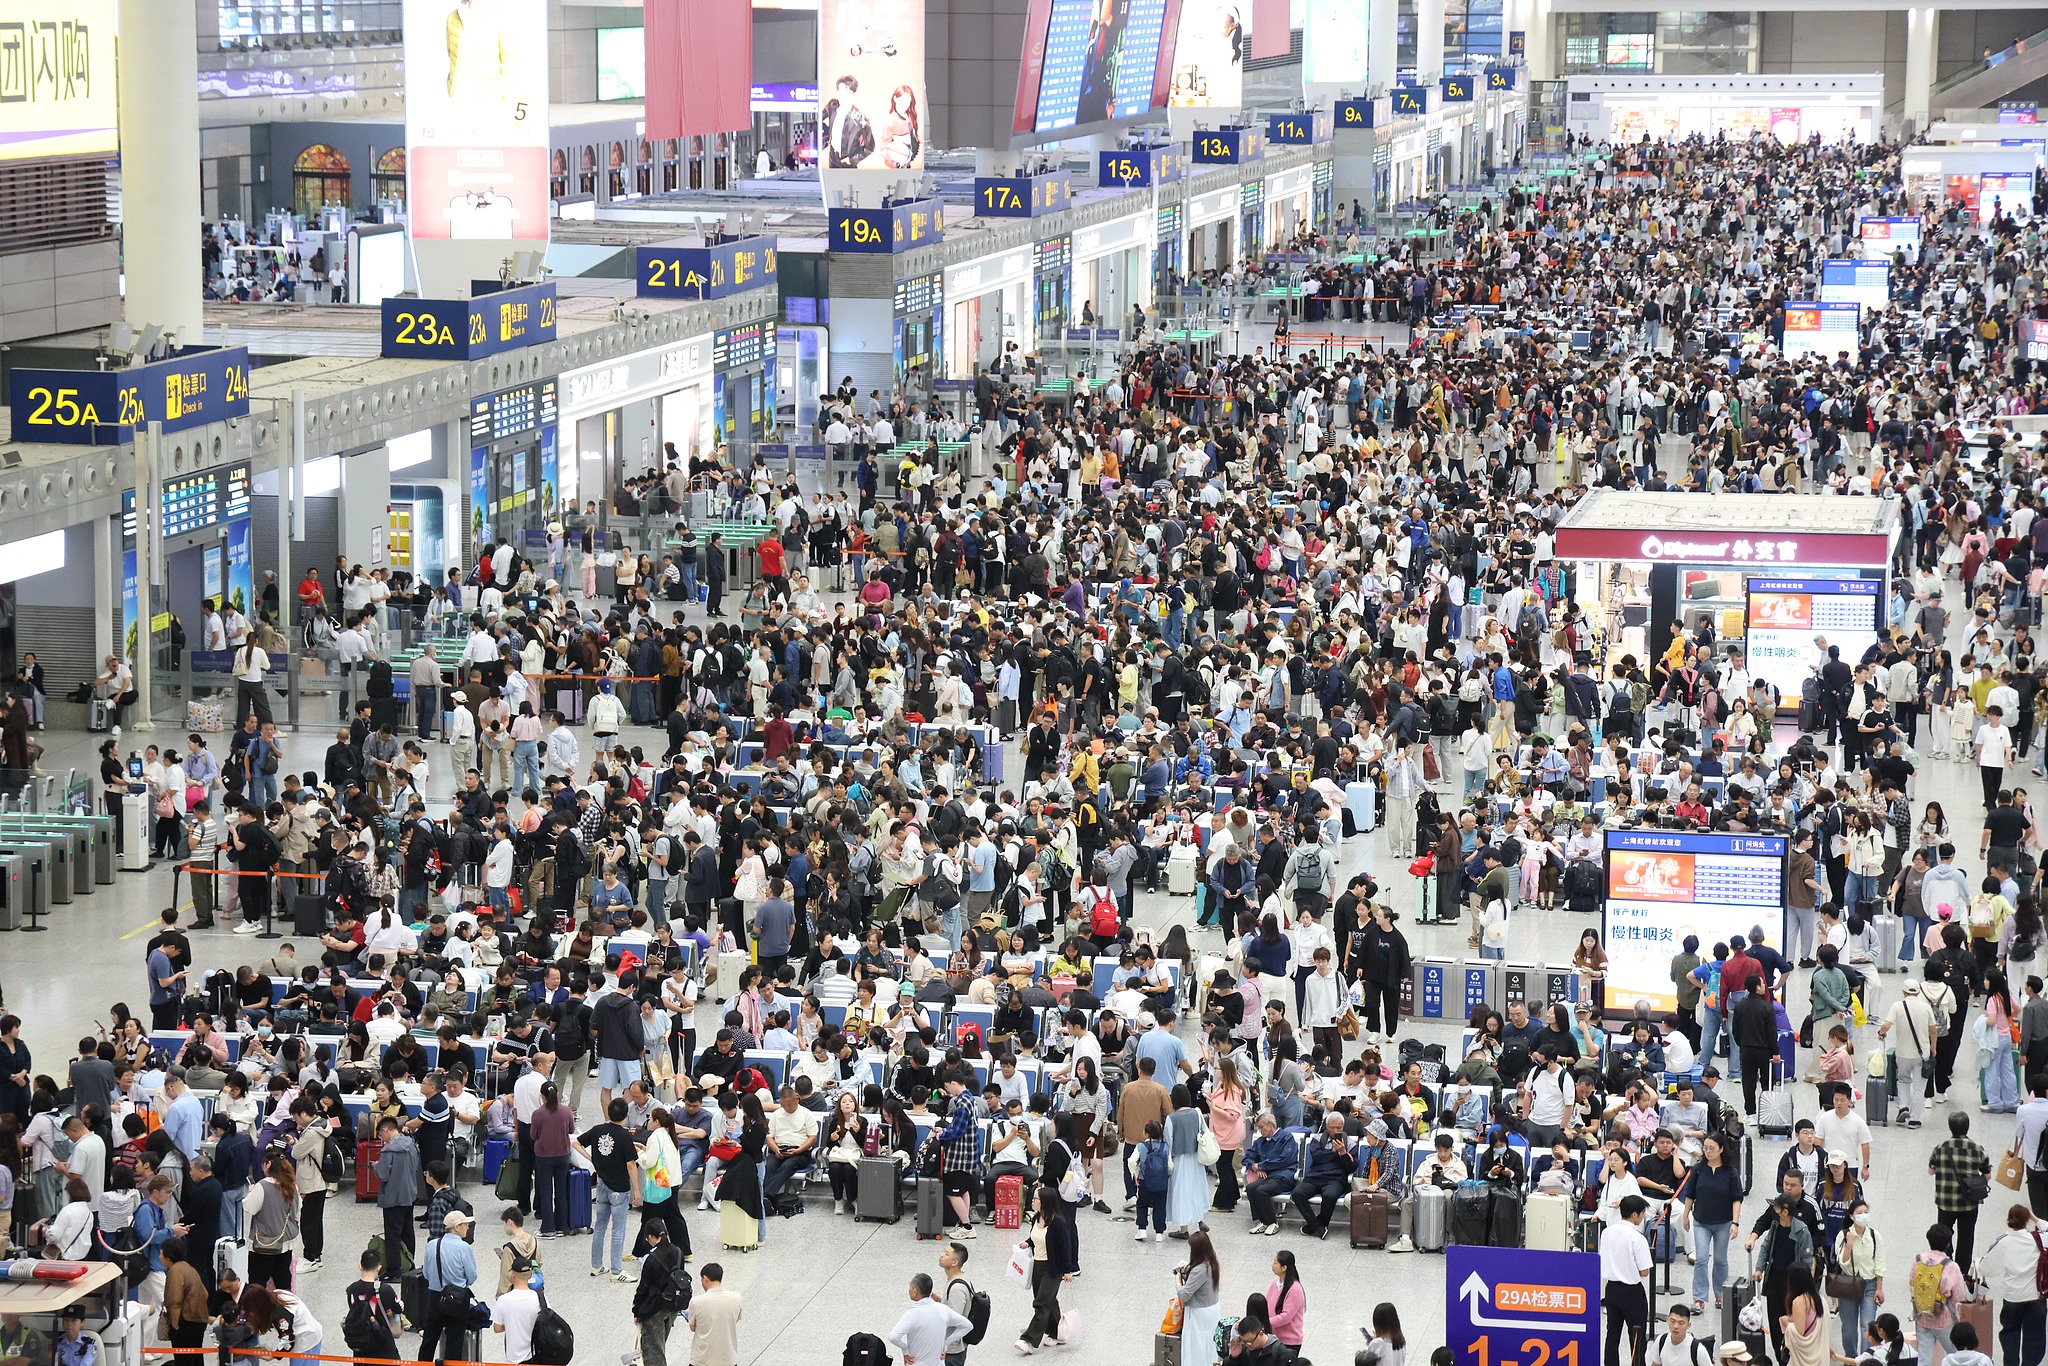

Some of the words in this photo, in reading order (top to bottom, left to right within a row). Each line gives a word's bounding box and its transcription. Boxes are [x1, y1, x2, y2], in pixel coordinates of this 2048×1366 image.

[1448, 83, 1464, 97] 5A
[1491, 73, 1507, 86] 3A
[514, 102, 528, 121] 5
[1399, 94, 1416, 109] 7A
[1345, 107, 1362, 123] 9A
[1277, 121, 1304, 138] 11A
[1200, 138, 1231, 157] 13A
[1108, 159, 1141, 179] 15A
[983, 186, 1022, 209] 17A
[839, 218, 882, 243] 19A
[647, 259, 700, 287] 21A
[711, 259, 725, 287] 21A
[540, 297, 556, 328] 22A
[395, 312, 455, 345] 23A
[469, 313, 487, 345] 23A
[182, 372, 208, 398] 检票口
[225, 365, 249, 402] 24A
[28, 387, 100, 426] 25A
[119, 387, 145, 425] 25A
[182, 401, 197, 414] Check
[1732, 539, 1798, 561] 外交官
[1752, 646, 1797, 658] 慢性咽炎
[1611, 924, 1674, 942] 慢性咽炎
[1500, 1289, 1582, 1309] 29A检票口
[1467, 1335, 1579, 1366] 1-21
